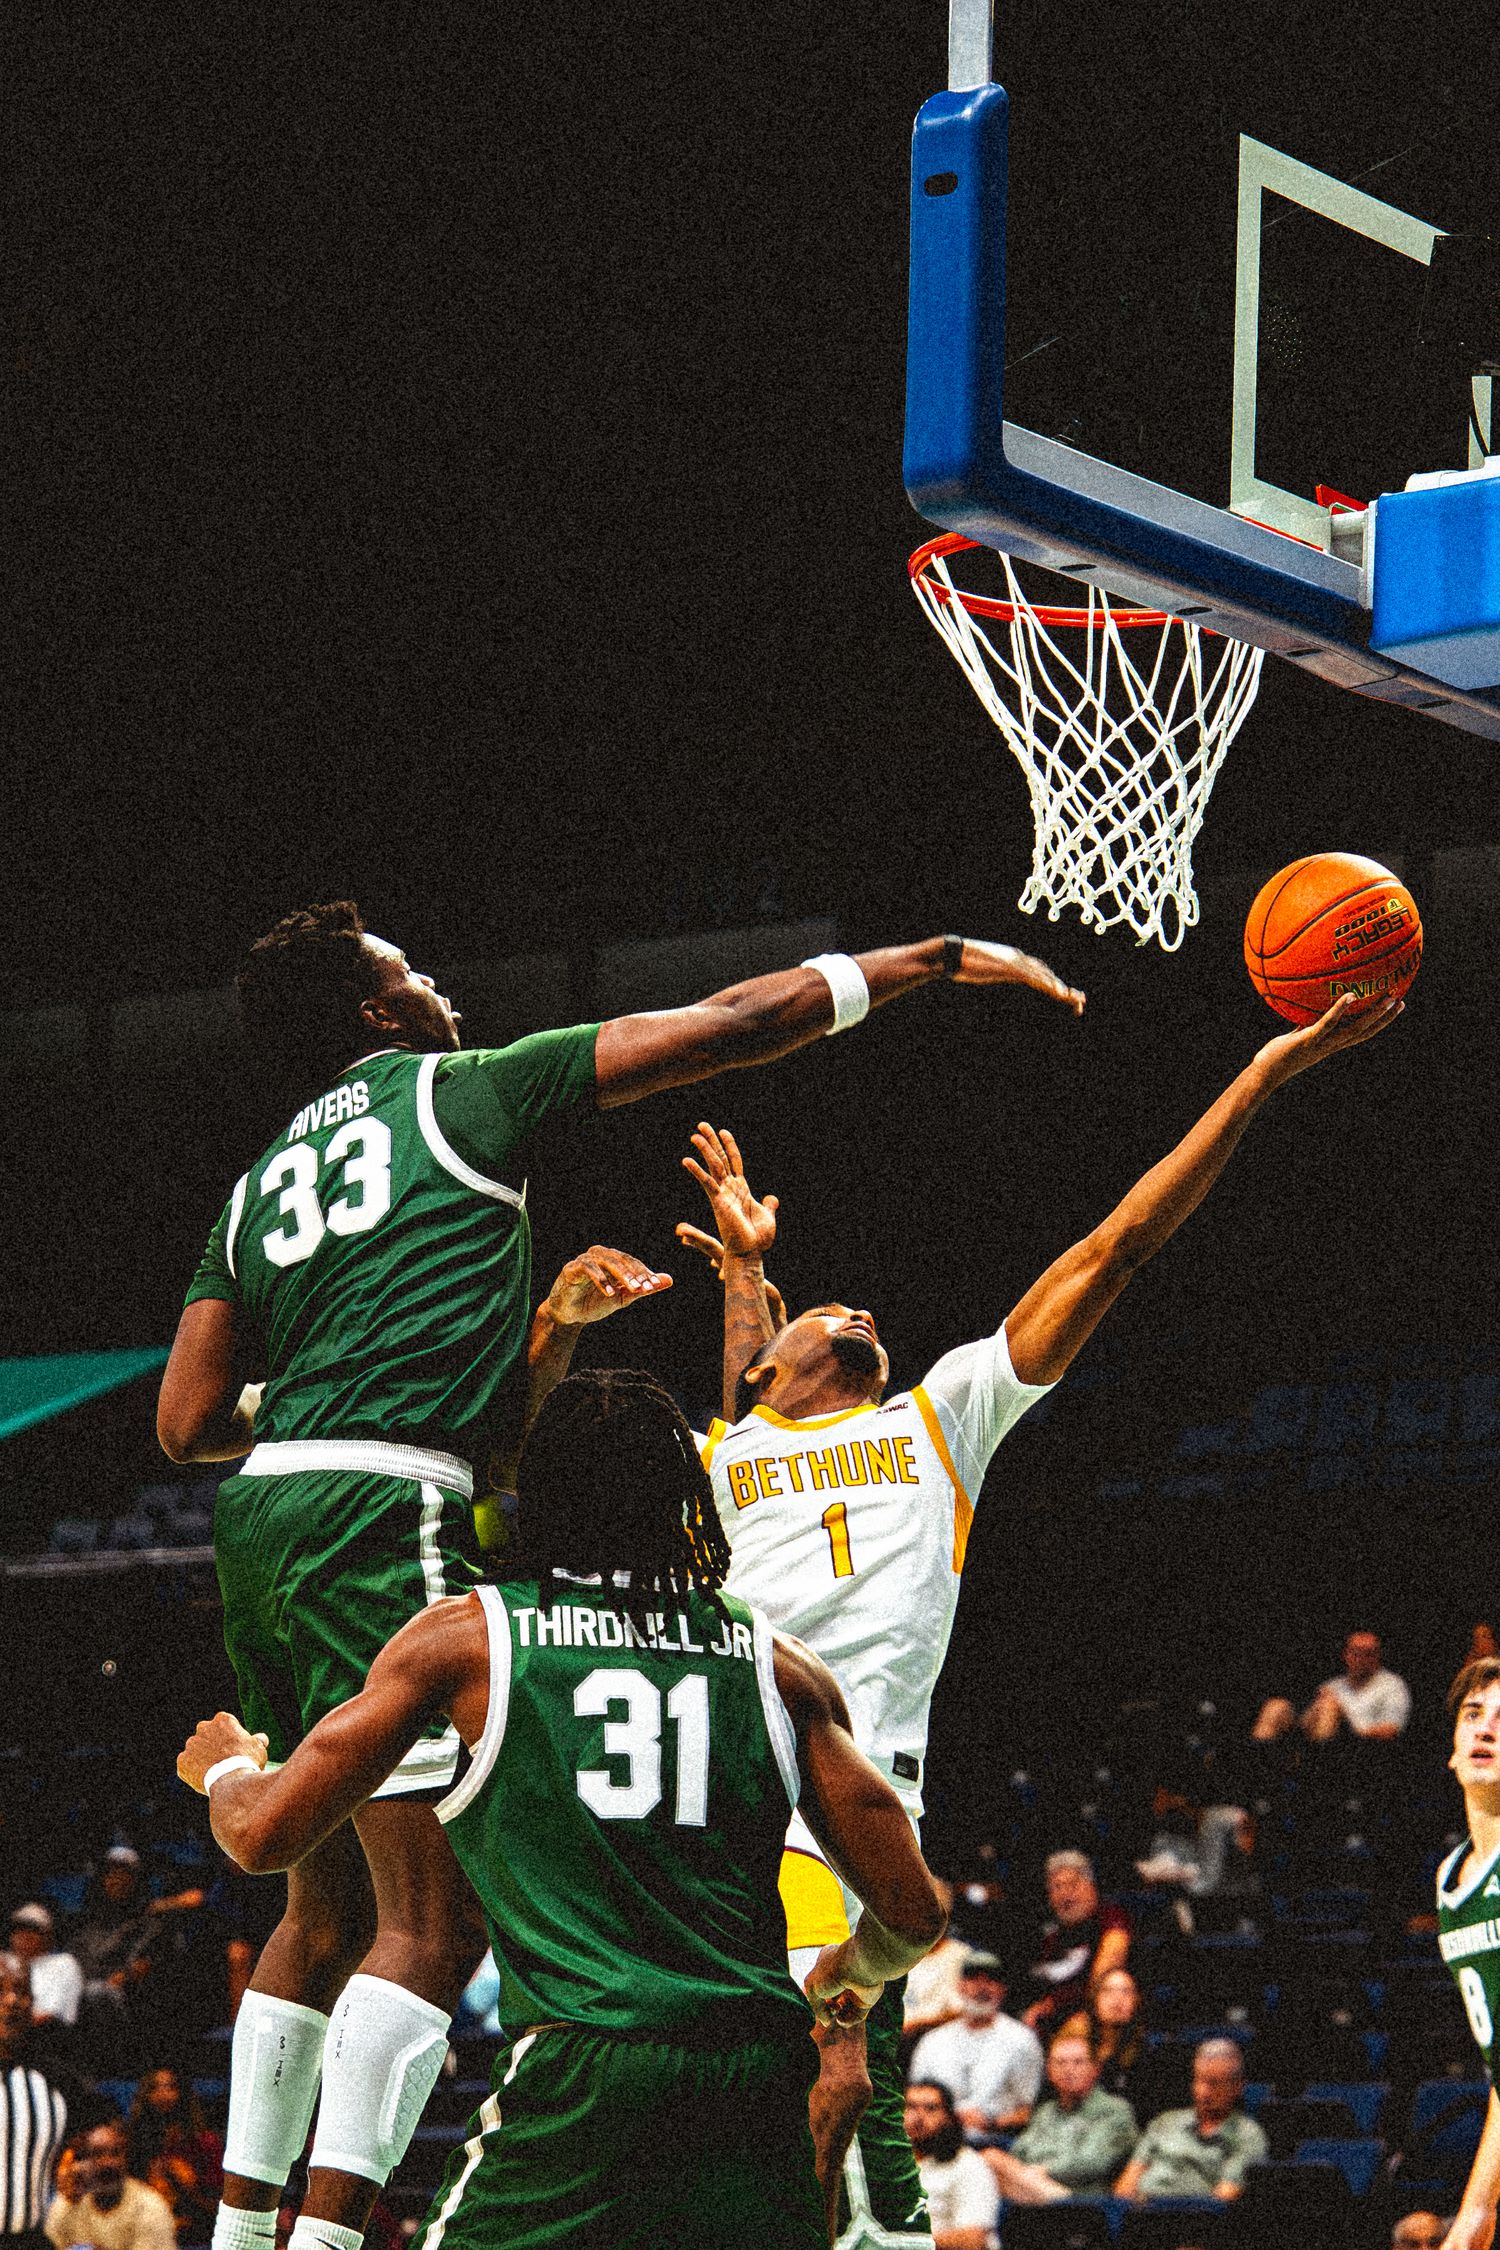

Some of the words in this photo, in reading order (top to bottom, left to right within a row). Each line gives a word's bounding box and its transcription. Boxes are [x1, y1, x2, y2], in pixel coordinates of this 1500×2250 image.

[1332, 907, 1412, 961] LEGACY
[1334, 905, 1387, 939] 1000
[287, 1080, 370, 1143] RIVERS
[260, 1115, 392, 1268] 33
[727, 1436, 920, 1511] BETHUNE
[821, 1502, 855, 1578] 1
[711, 1619, 754, 1662] JR
[573, 1668, 710, 1827] 31
